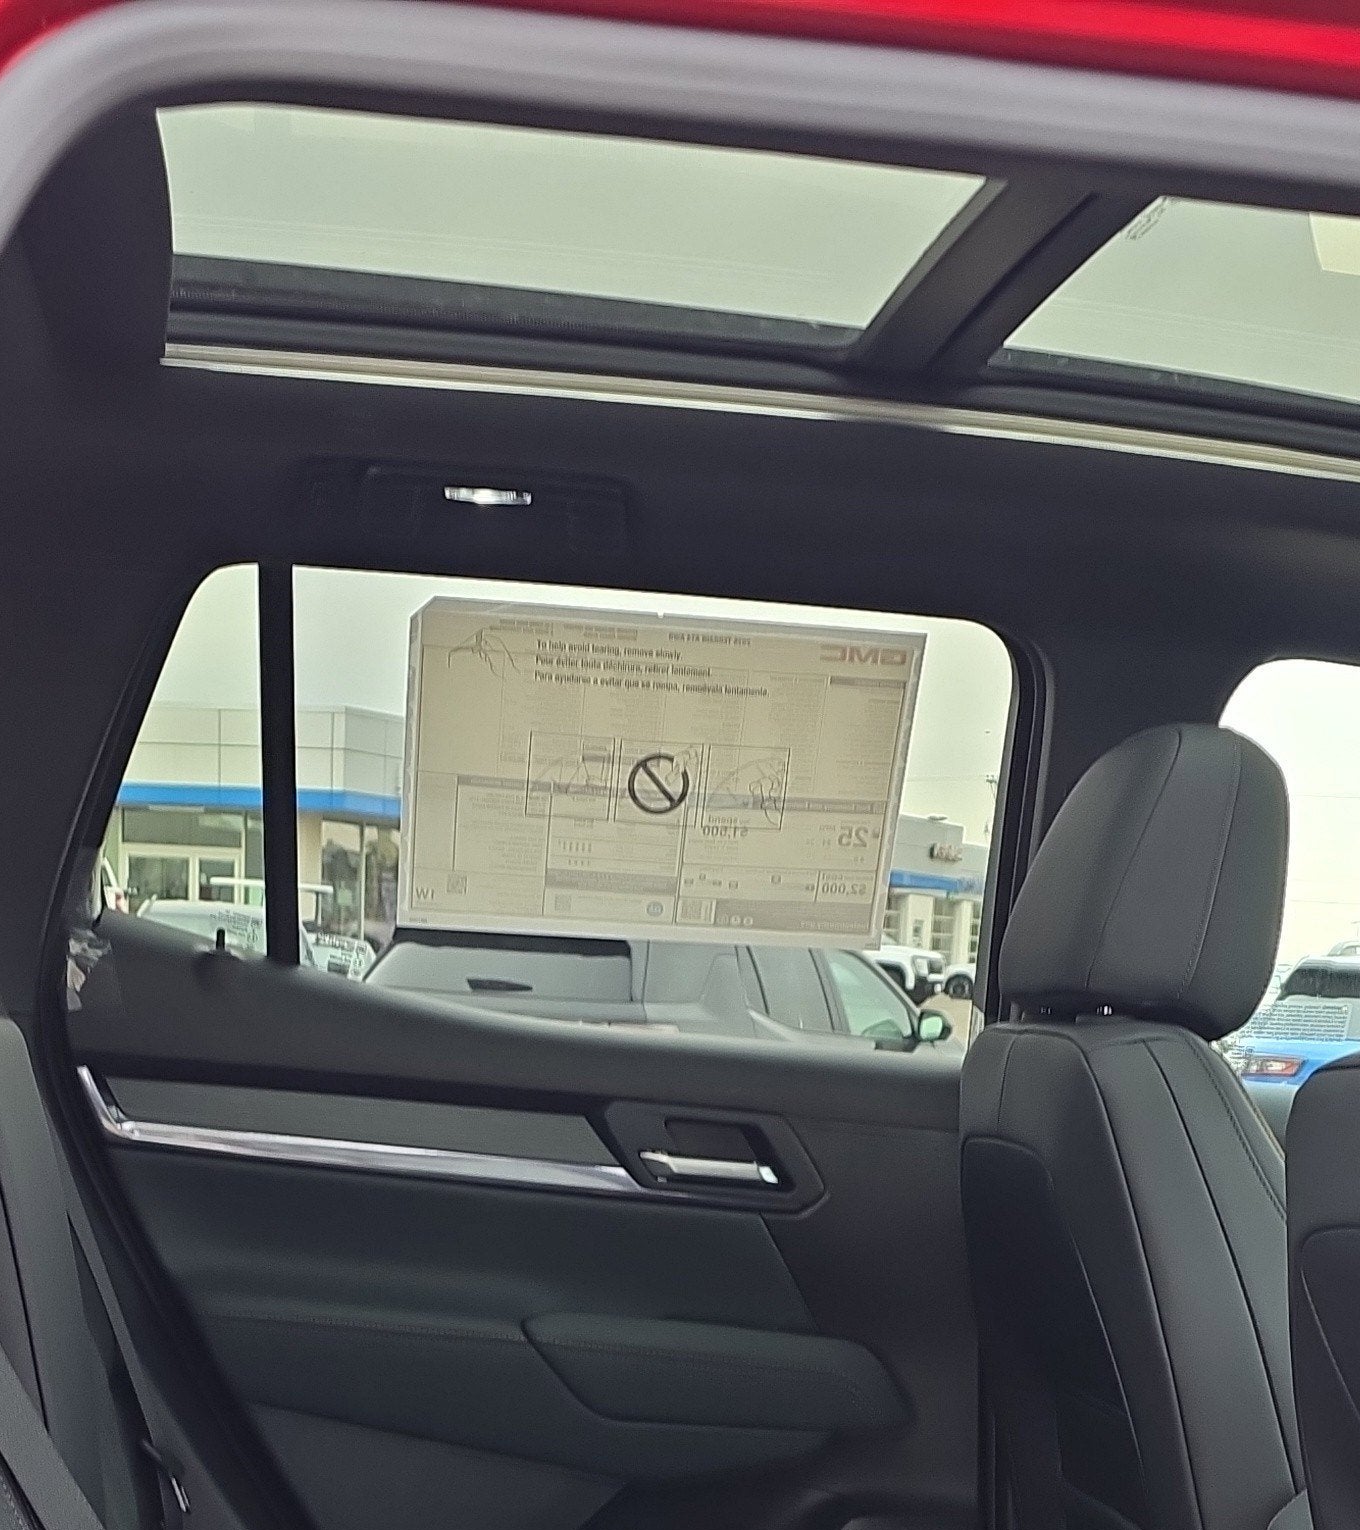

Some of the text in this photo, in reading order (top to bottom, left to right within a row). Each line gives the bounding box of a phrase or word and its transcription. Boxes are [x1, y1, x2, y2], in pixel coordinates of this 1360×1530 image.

[537, 638, 547, 650] To
[548, 639, 567, 653] help
[568, 641, 590, 653] avoid
[623, 646, 653, 658] remove
[655, 648, 683, 661] slowly.
[534, 669, 554, 682] Para
[624, 679, 640, 691] que
[641, 679, 651, 689] se
